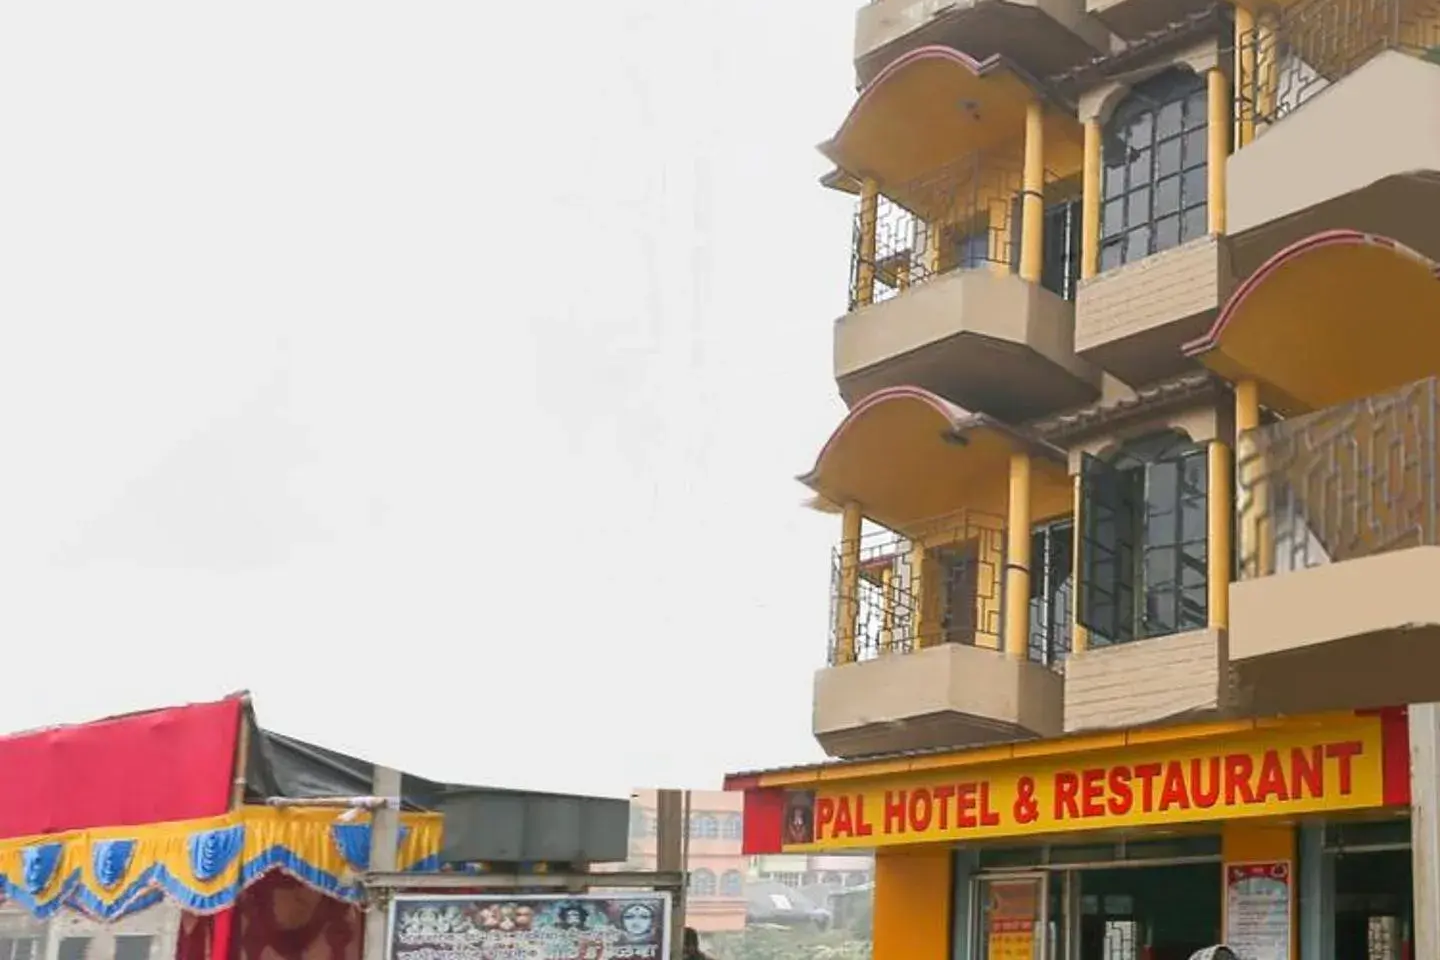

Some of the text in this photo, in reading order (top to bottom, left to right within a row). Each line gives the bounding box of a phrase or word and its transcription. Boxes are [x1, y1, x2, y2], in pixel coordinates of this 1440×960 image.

[815, 740, 1363, 840] PAL HOTEL & RESTAURANT
